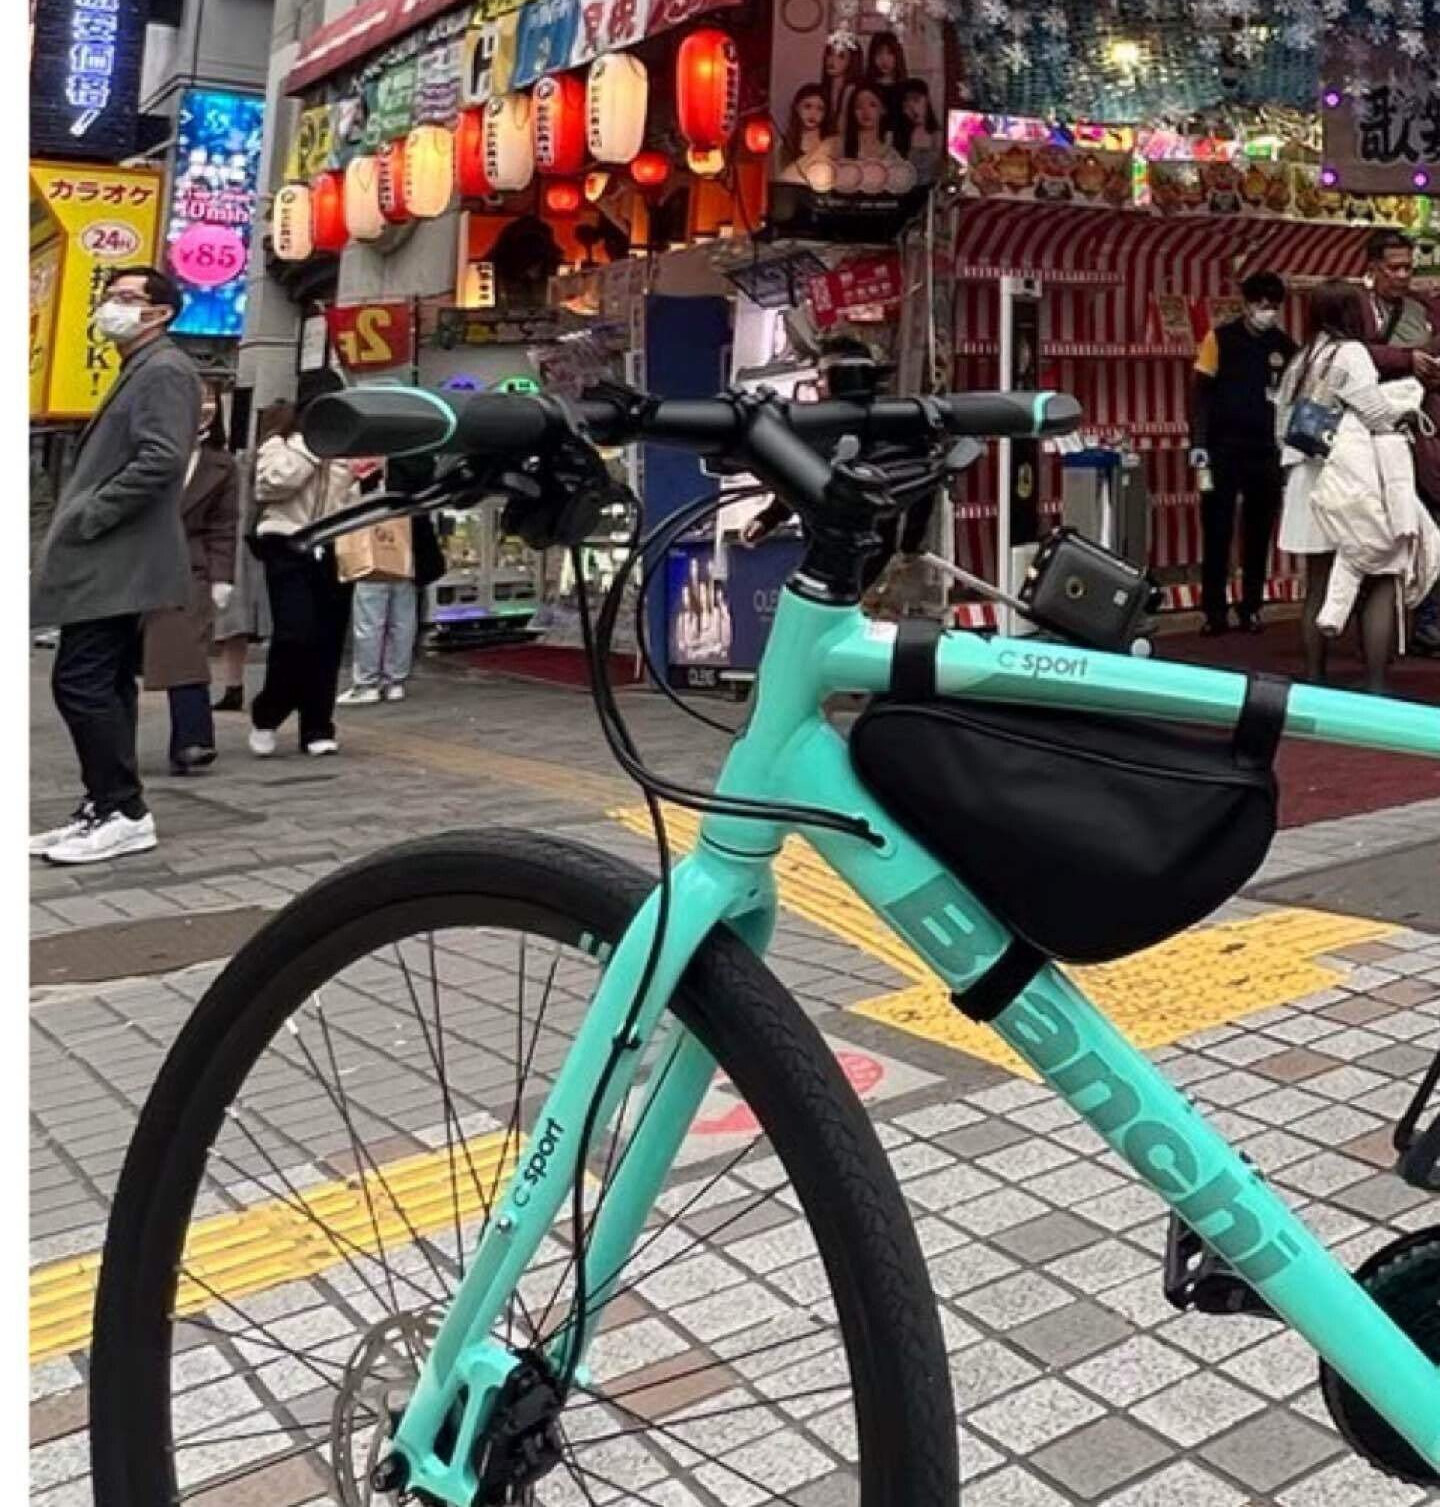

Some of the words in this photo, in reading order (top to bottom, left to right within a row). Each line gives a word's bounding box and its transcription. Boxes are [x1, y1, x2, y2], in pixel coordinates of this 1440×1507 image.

[49, 179, 154, 205] カラオケ
[1021, 653, 1088, 680] sport
[917, 894, 1304, 1287] Banchi
[523, 1117, 566, 1186] sport
